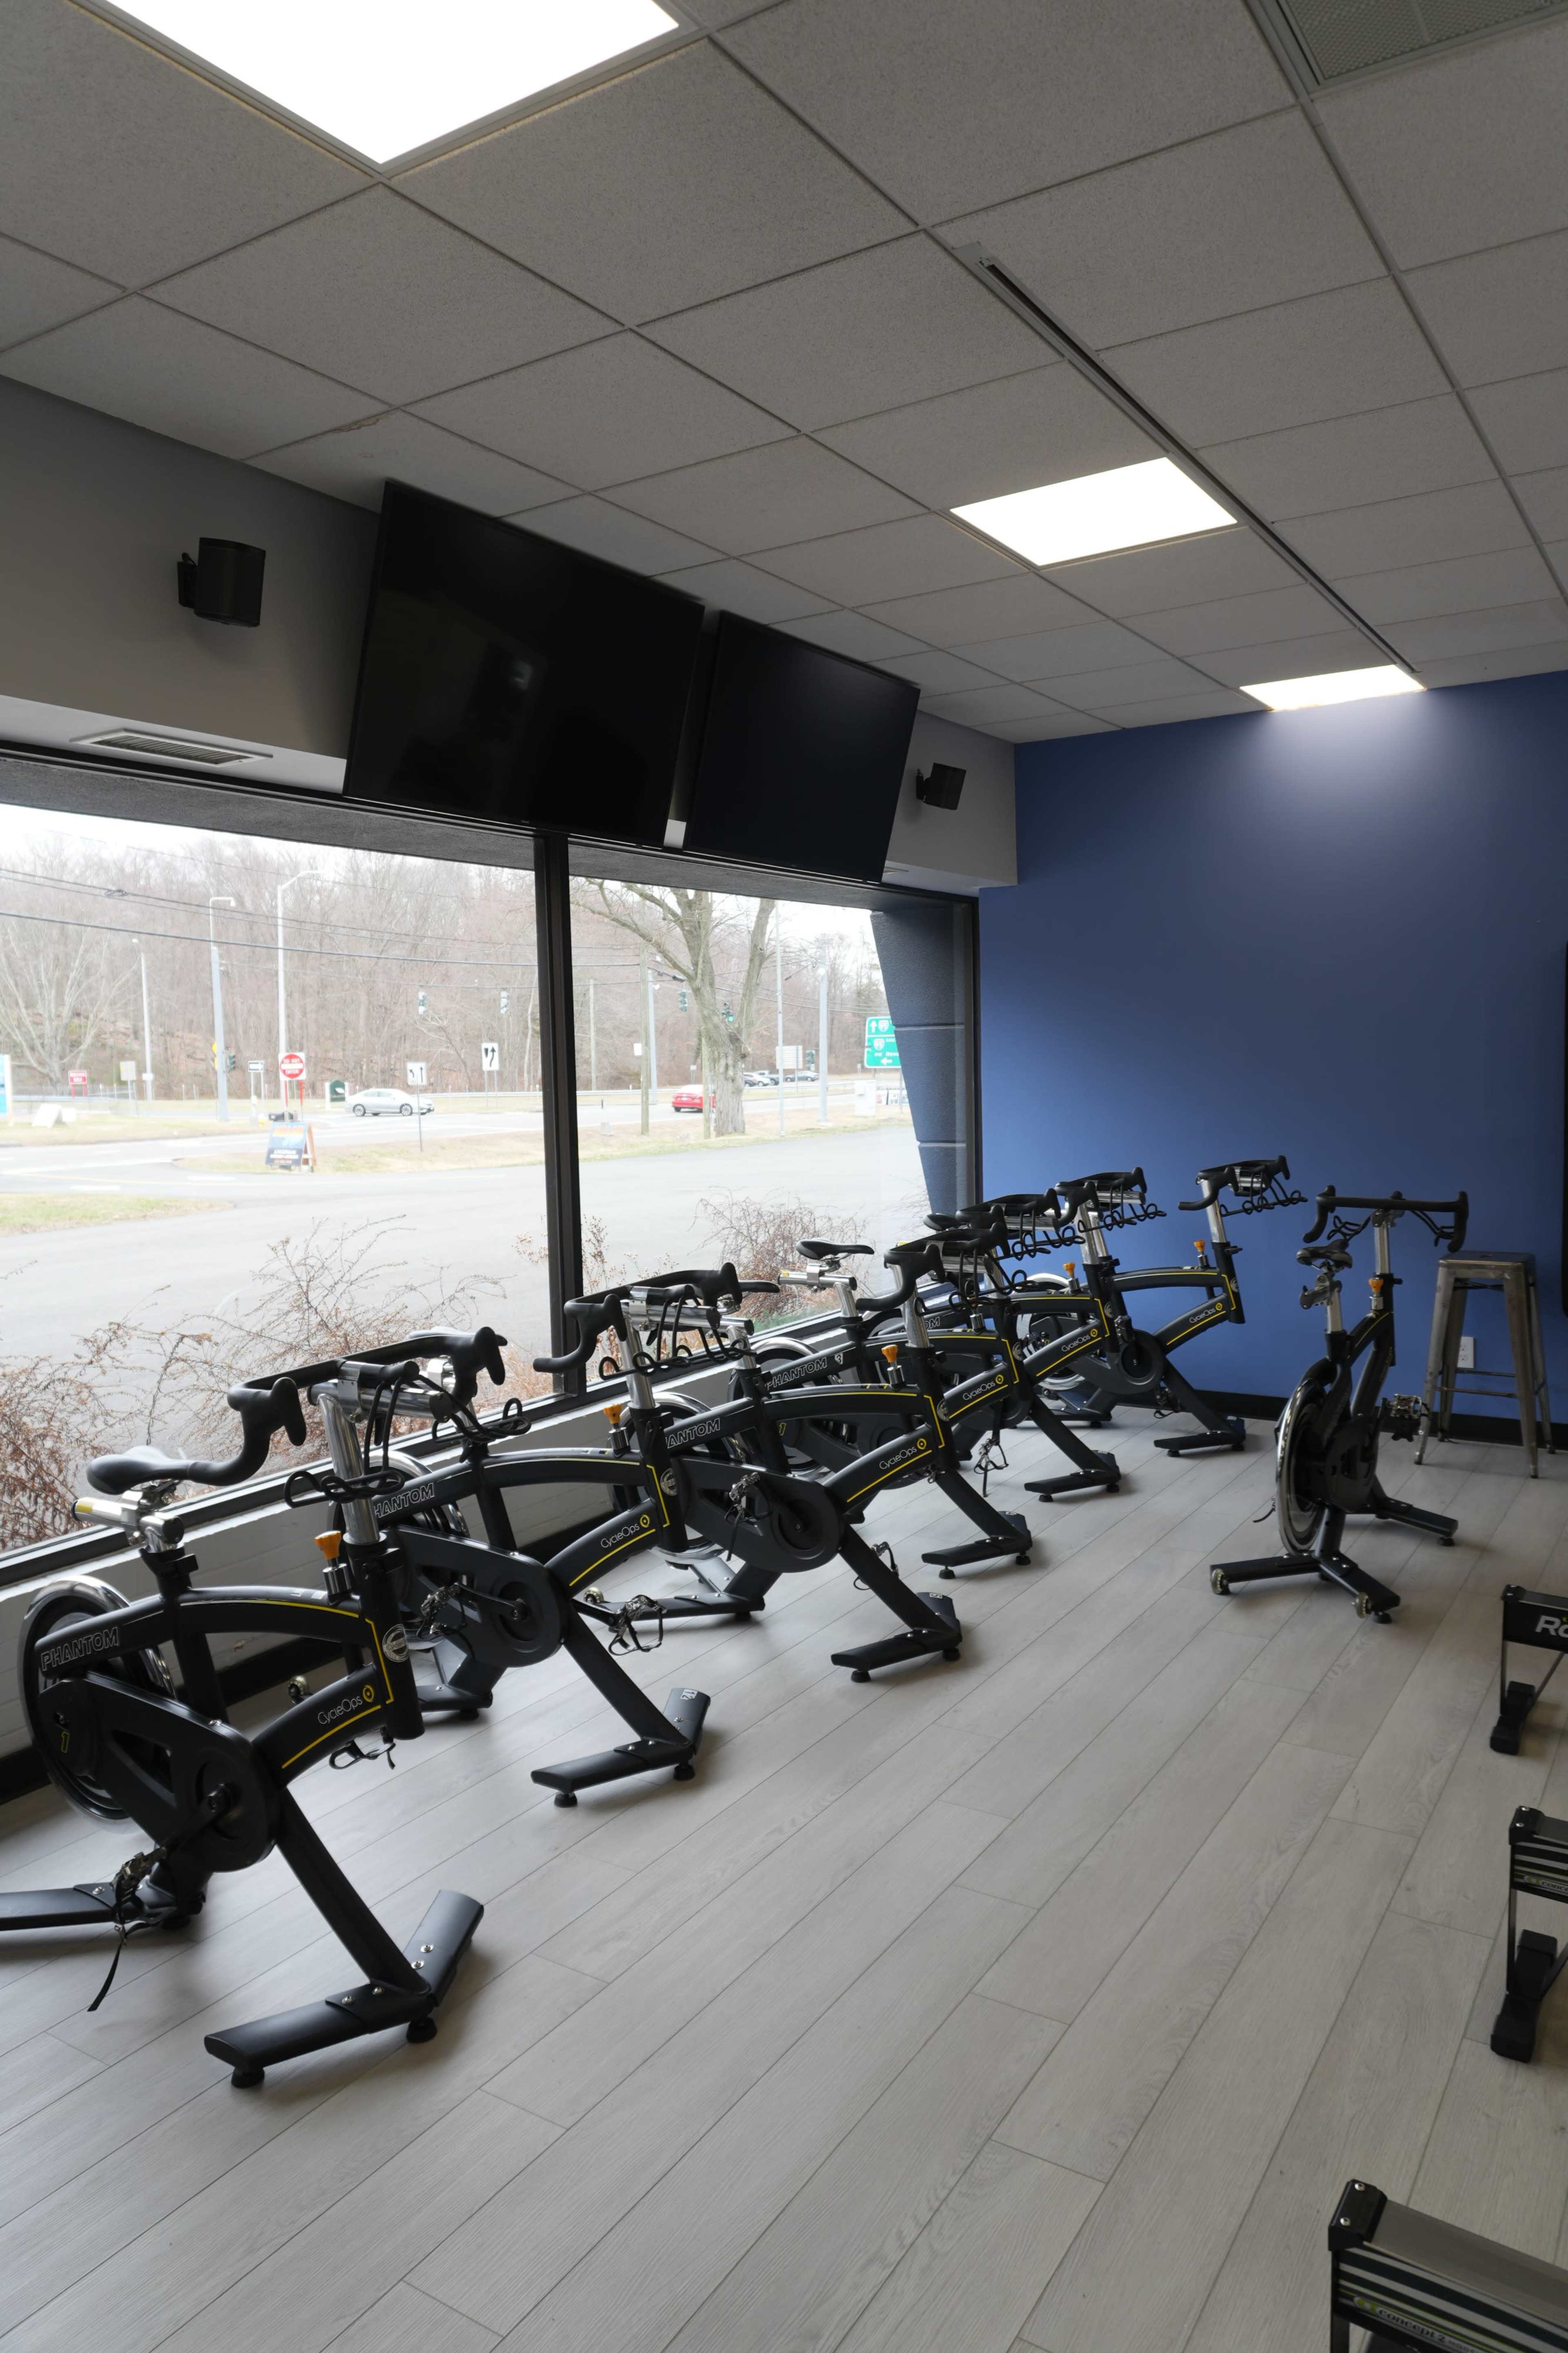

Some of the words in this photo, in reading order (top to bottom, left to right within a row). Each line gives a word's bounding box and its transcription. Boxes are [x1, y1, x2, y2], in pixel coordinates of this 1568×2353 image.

[962, 1381, 996, 1400] CycleOps
[665, 1418, 720, 1449] ANTOM
[879, 1446, 917, 1470] CycleOps
[373, 1482, 435, 1518] HANTOM
[601, 1523, 640, 1548] CycleOps
[40, 1626, 119, 1671] PHANTOM
[317, 1696, 363, 1724] CycleOps
